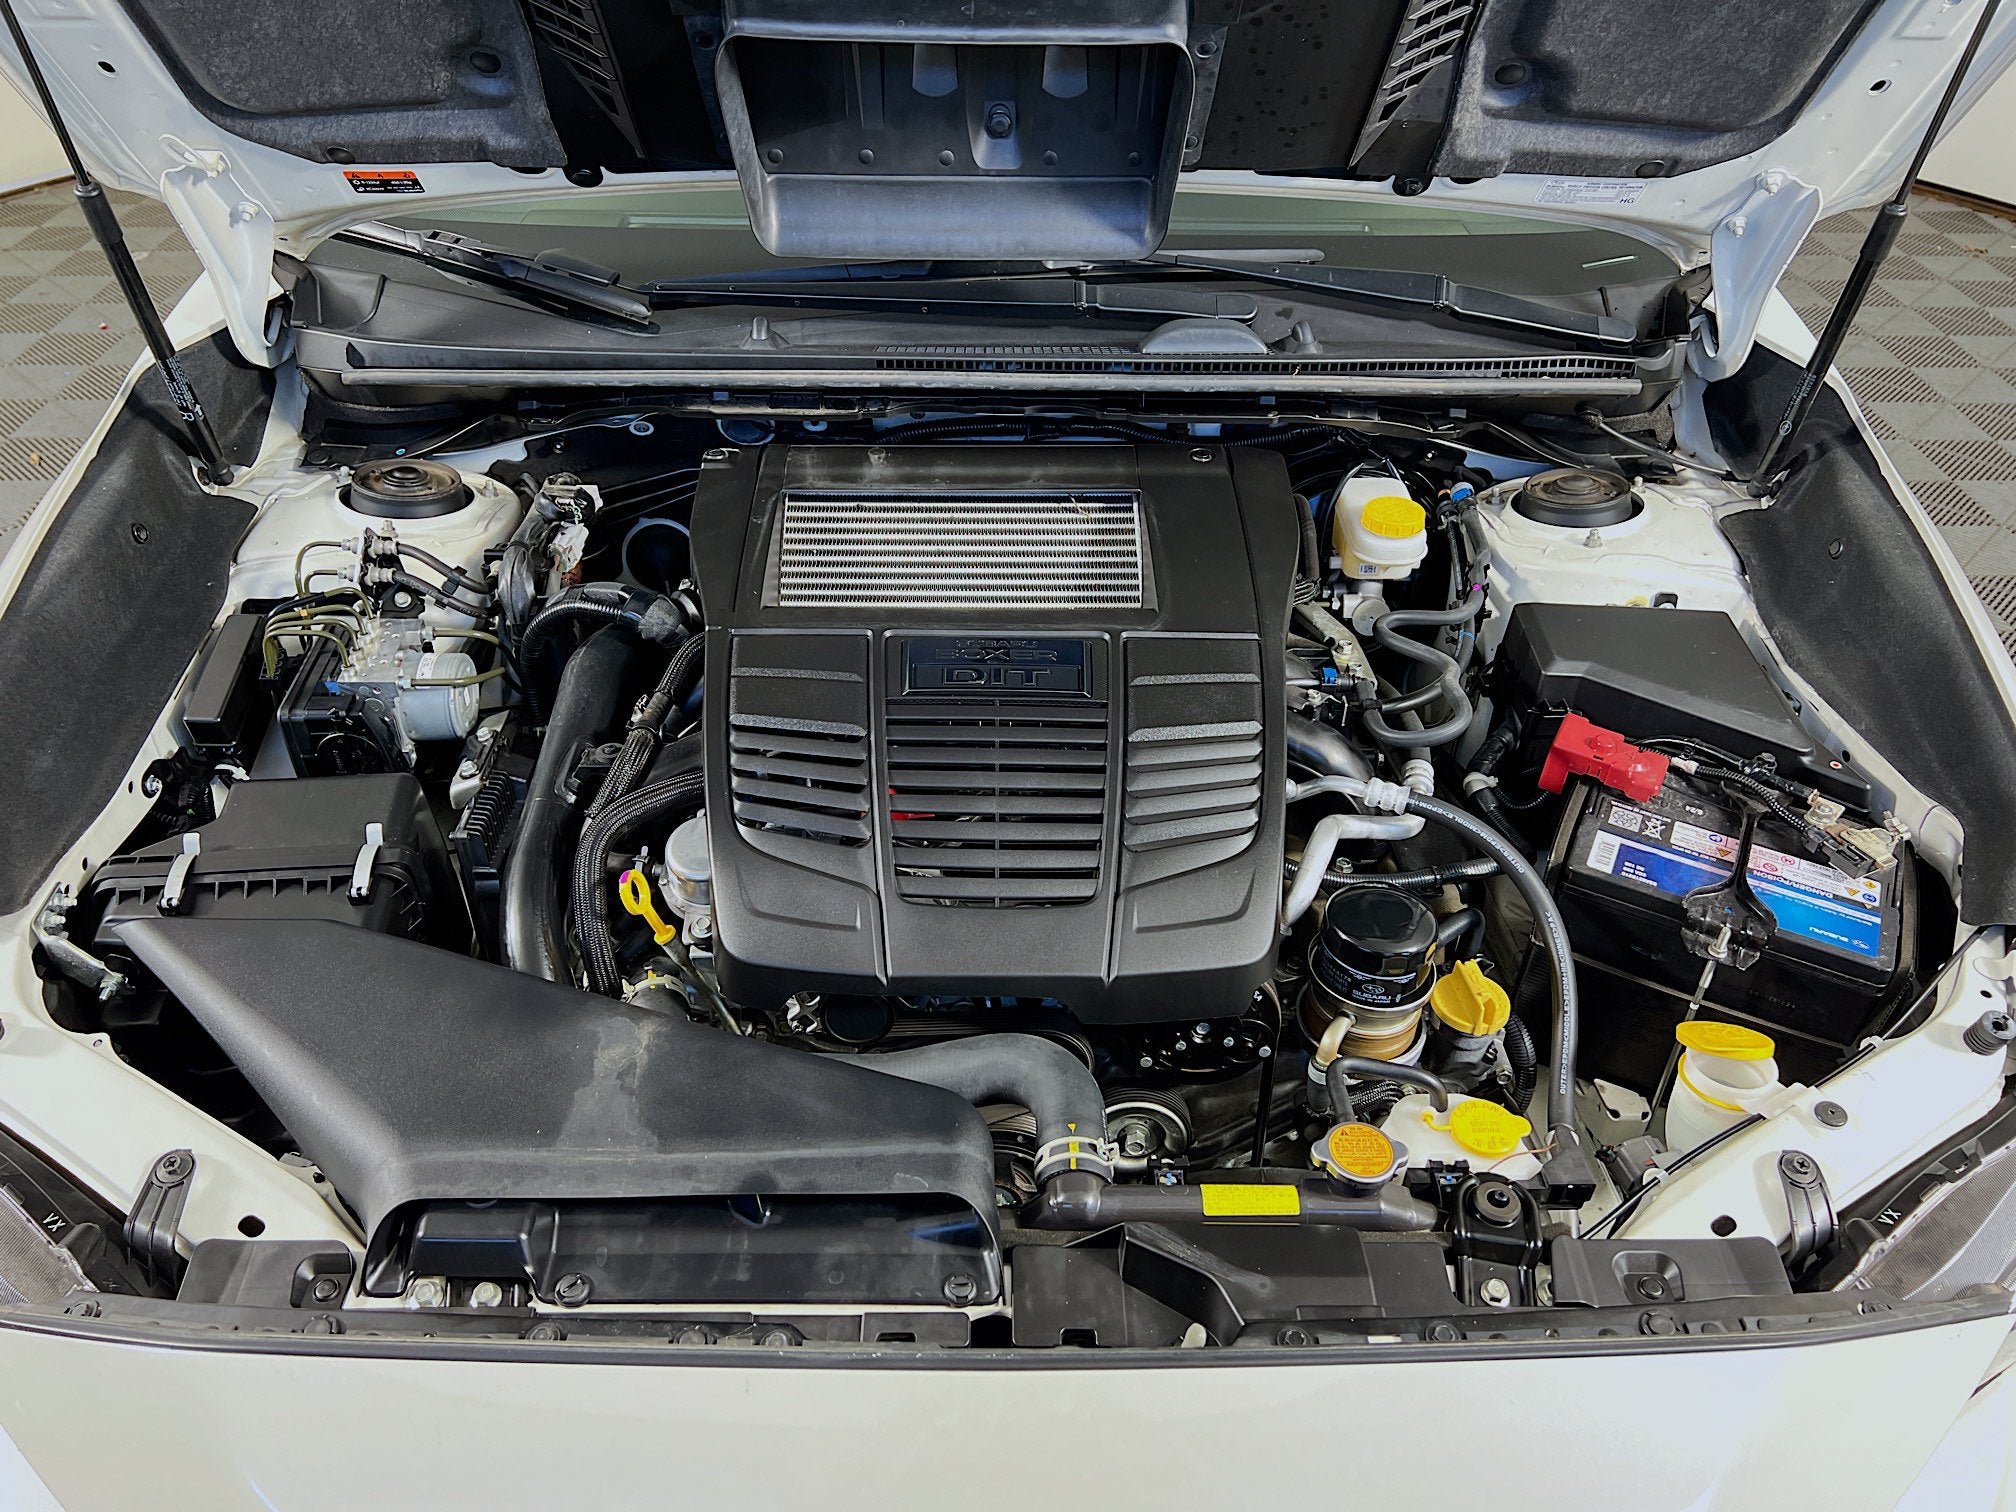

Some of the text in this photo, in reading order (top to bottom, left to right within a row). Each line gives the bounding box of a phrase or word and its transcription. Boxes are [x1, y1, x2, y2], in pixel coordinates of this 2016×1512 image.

[935, 649, 1058, 661] BOXER
[943, 667, 1050, 686] DIT
[1752, 869, 1834, 899] DANGER/POISON
[1809, 926, 1849, 943] SUBARU
[1352, 990, 1392, 1000] SUBARU
[42, 1212, 66, 1232] VX
[1878, 1208, 1902, 1225] VX
